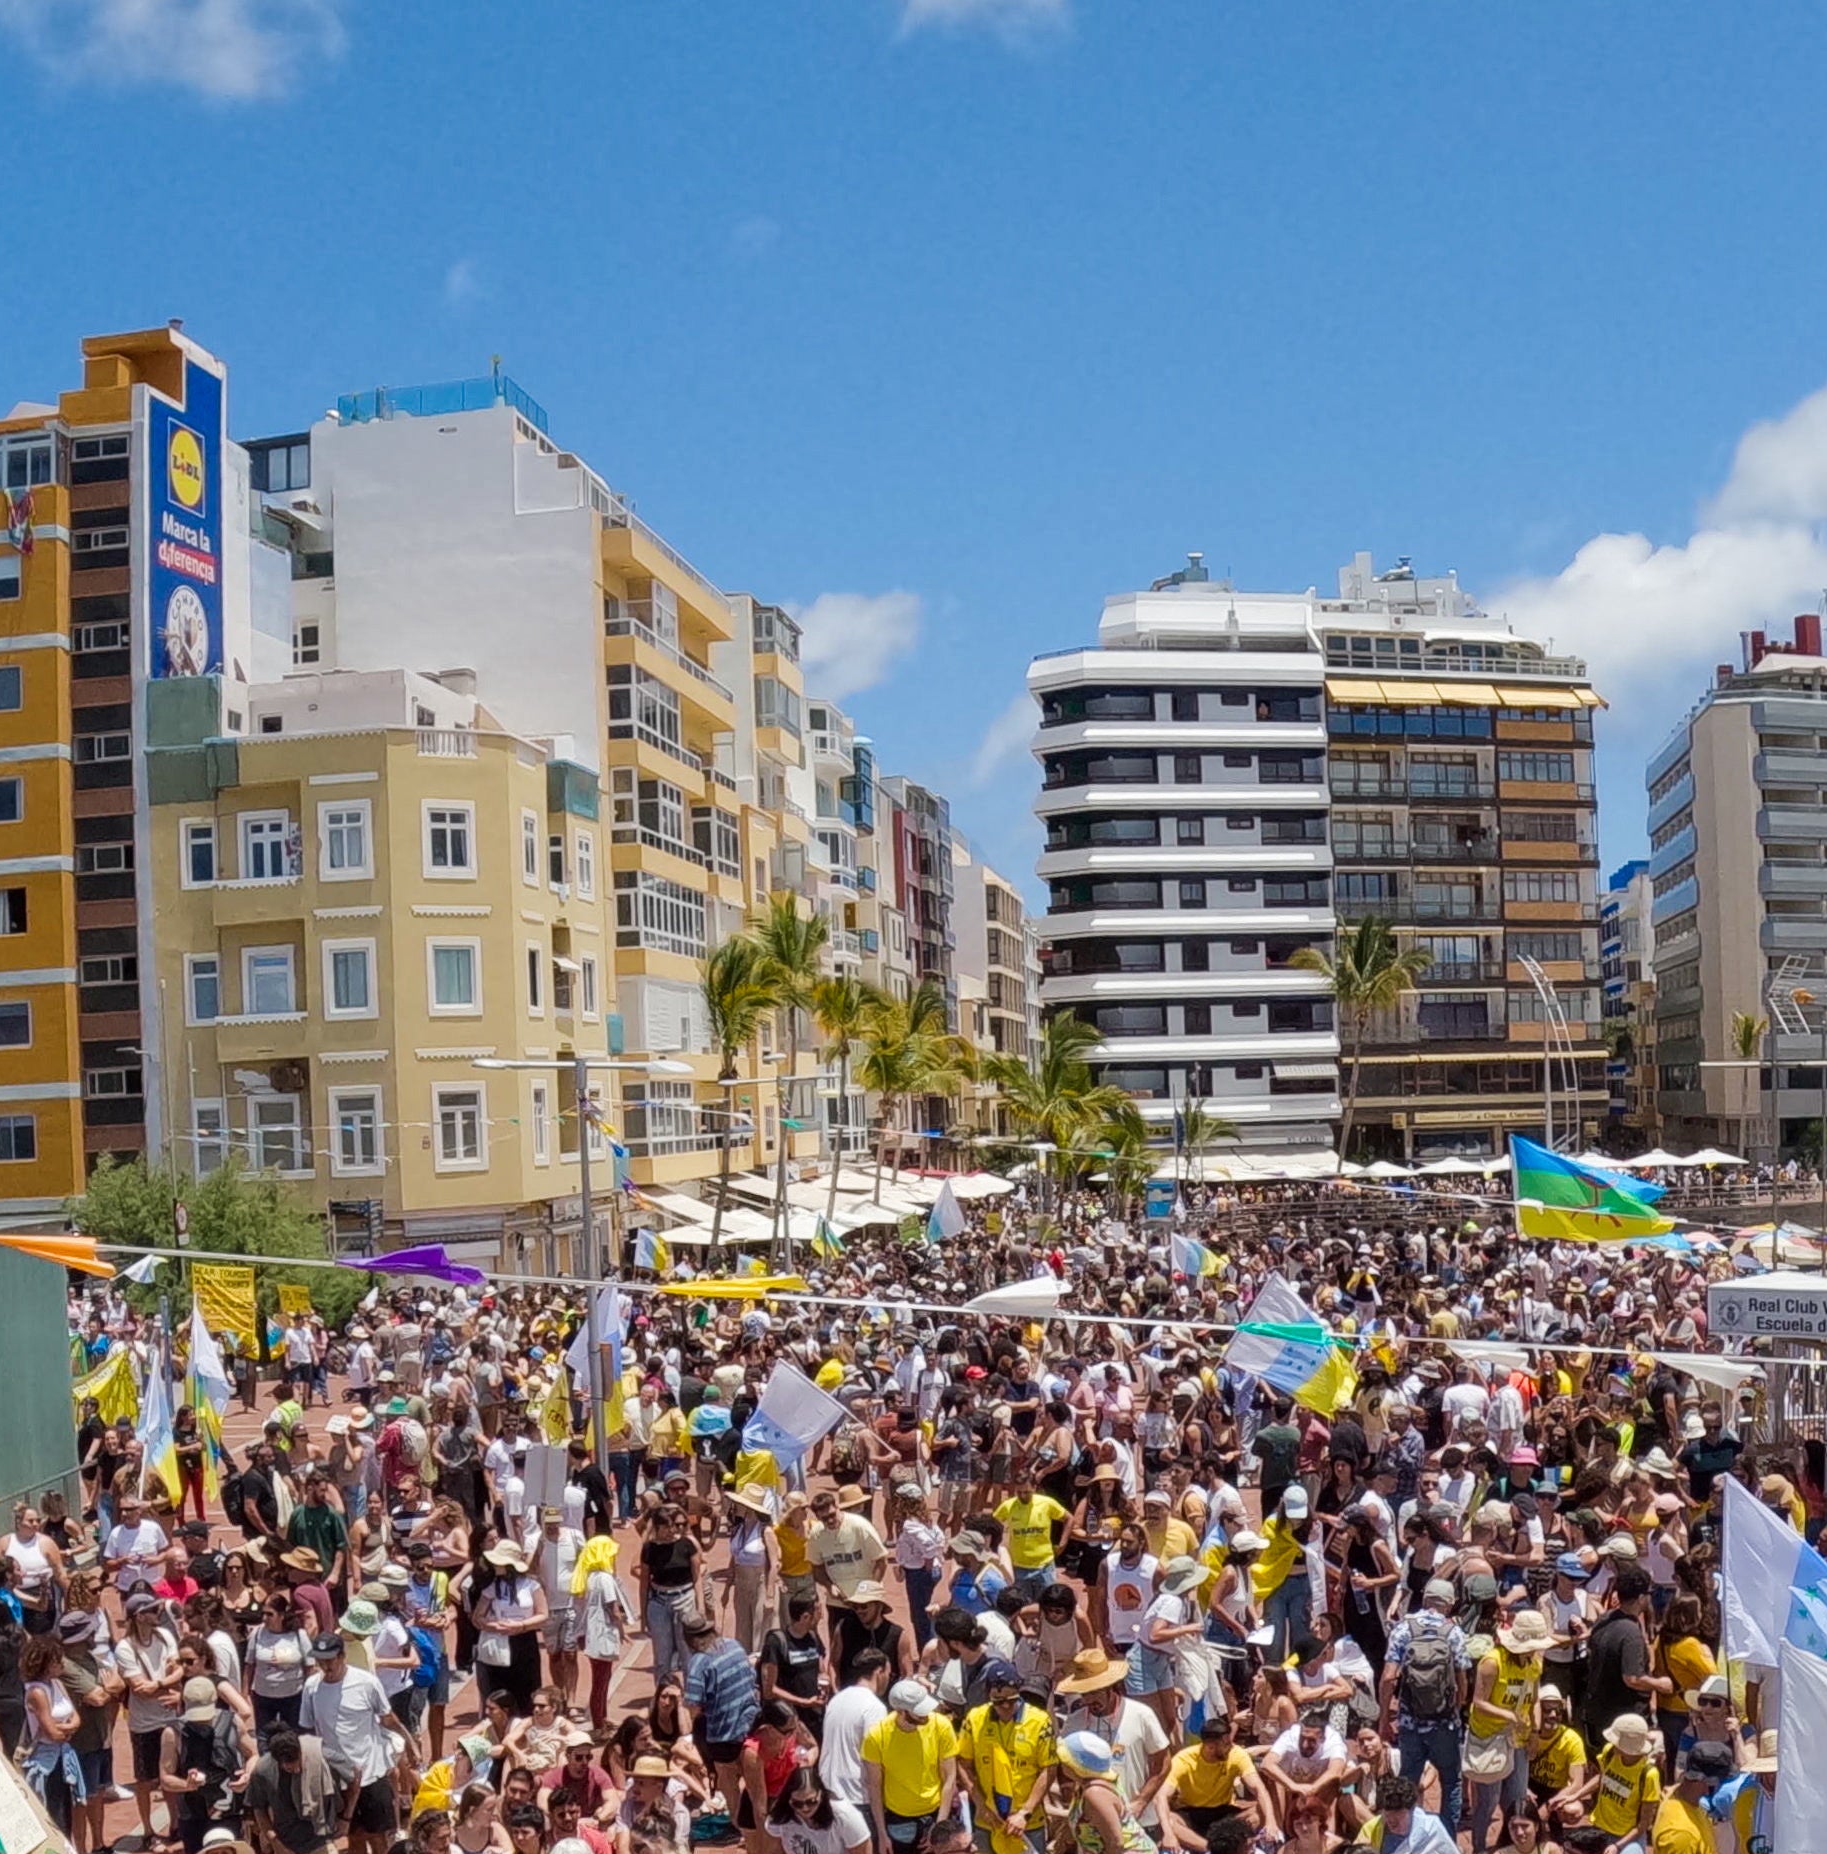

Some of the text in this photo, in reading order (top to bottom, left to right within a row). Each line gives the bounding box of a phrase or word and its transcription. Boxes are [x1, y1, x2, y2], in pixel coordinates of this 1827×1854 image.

[162, 510, 211, 553] Marca la
[1747, 1297, 1781, 1314] Real
[1785, 1298, 1819, 1316] Club
[1755, 1315, 1813, 1333] Escuela
